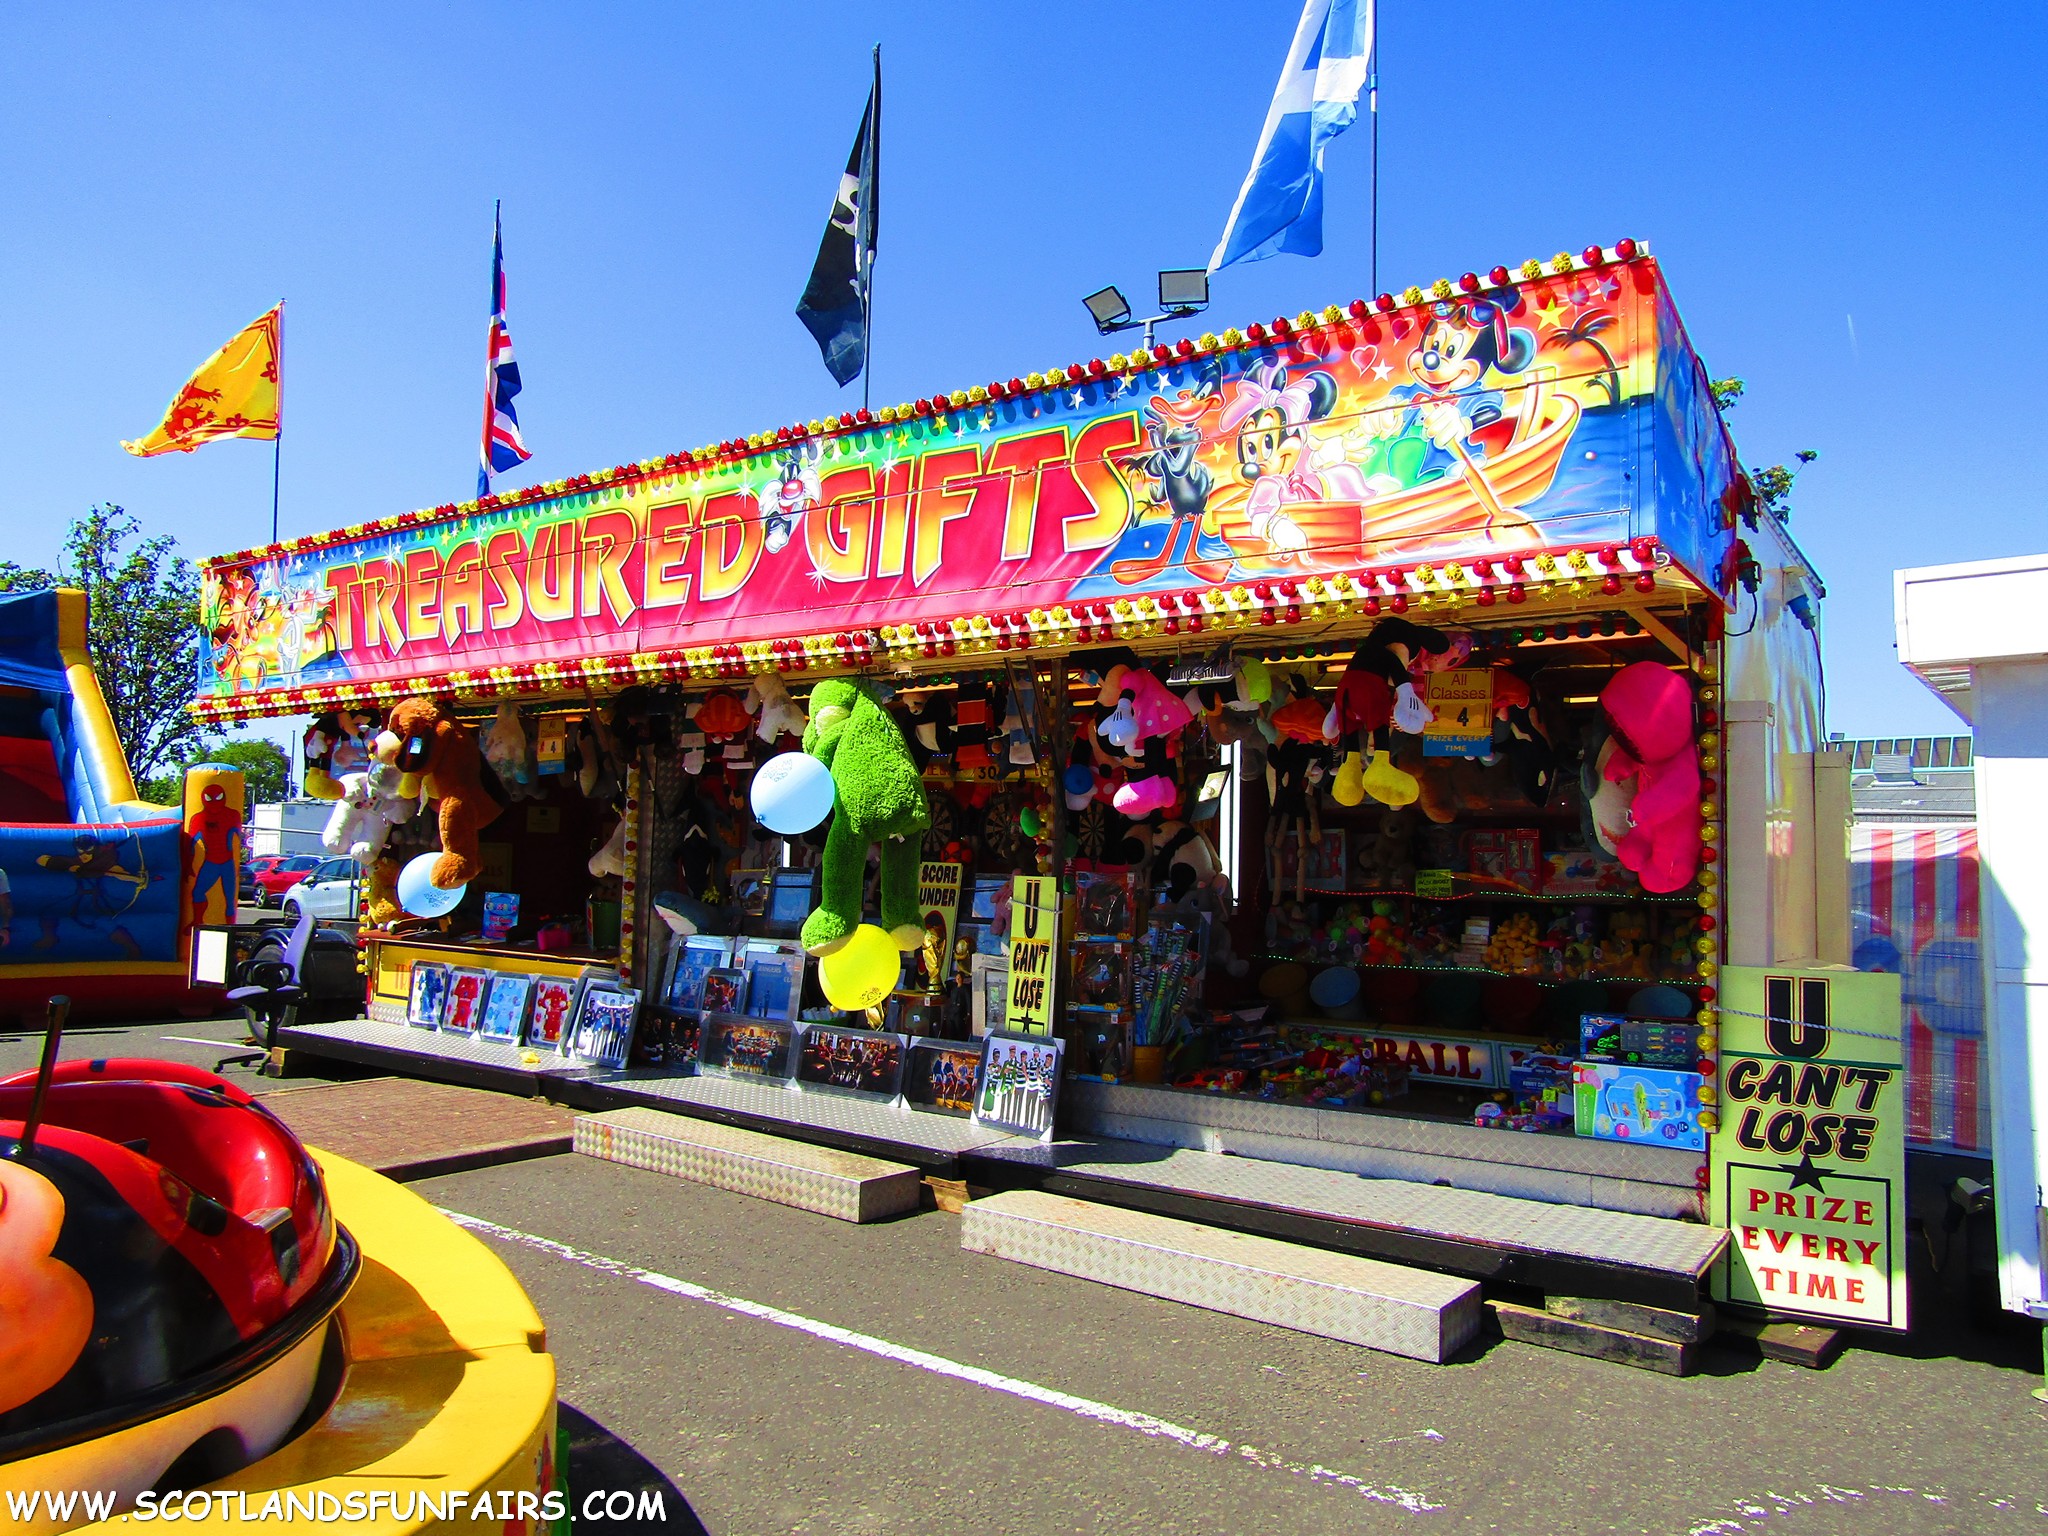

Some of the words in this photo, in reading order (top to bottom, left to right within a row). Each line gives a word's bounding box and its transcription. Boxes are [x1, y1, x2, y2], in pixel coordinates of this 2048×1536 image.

[326, 489, 766, 655] TREASURED
[804, 411, 1141, 588] GIFTS
[1431, 686, 1487, 700] Classes
[1451, 673, 1467, 686] All
[1457, 706, 1470, 727] 4
[1445, 744, 1468, 752] TIME
[978, 766, 997, 780] 30
[921, 864, 959, 884] SCORE
[919, 887, 957, 907] UNDER
[1024, 879, 1042, 939] U
[1012, 943, 1050, 976] CAN'T
[1012, 976, 1045, 1012] LOSE
[1764, 975, 1831, 1060] U
[1373, 1037, 1482, 1080] BALL
[1725, 1057, 1893, 1114] CAN'T
[1736, 1105, 1880, 1162] LOSE
[1747, 1188, 1875, 1227] PRIZE
[1740, 1225, 1882, 1266] EVERY
[1757, 1266, 1866, 1304] TIME
